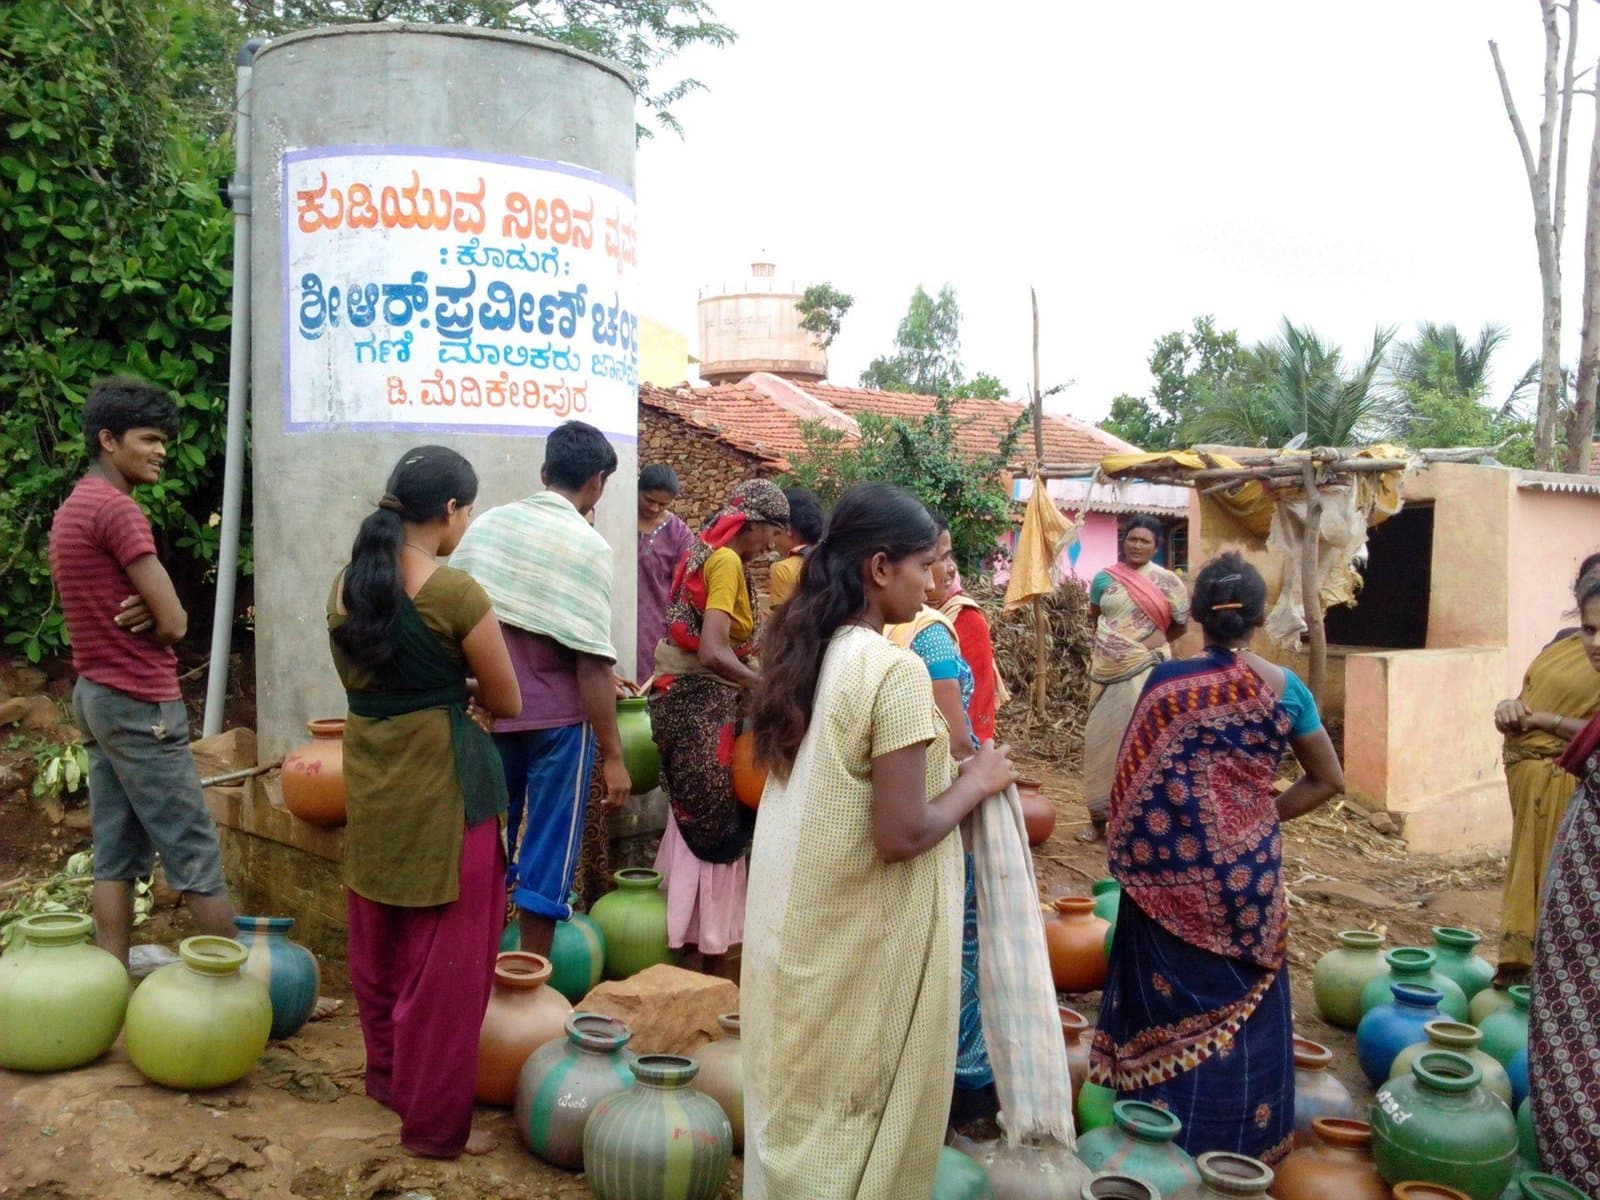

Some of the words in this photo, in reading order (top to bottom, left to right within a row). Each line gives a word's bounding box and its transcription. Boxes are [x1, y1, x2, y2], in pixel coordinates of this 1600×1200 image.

[296, 169, 486, 234] ಕುಡಿಯುವ
[502, 191, 594, 250] ನೀರಿನ
[437, 337, 581, 372] ಮಾಲಿಕರು
